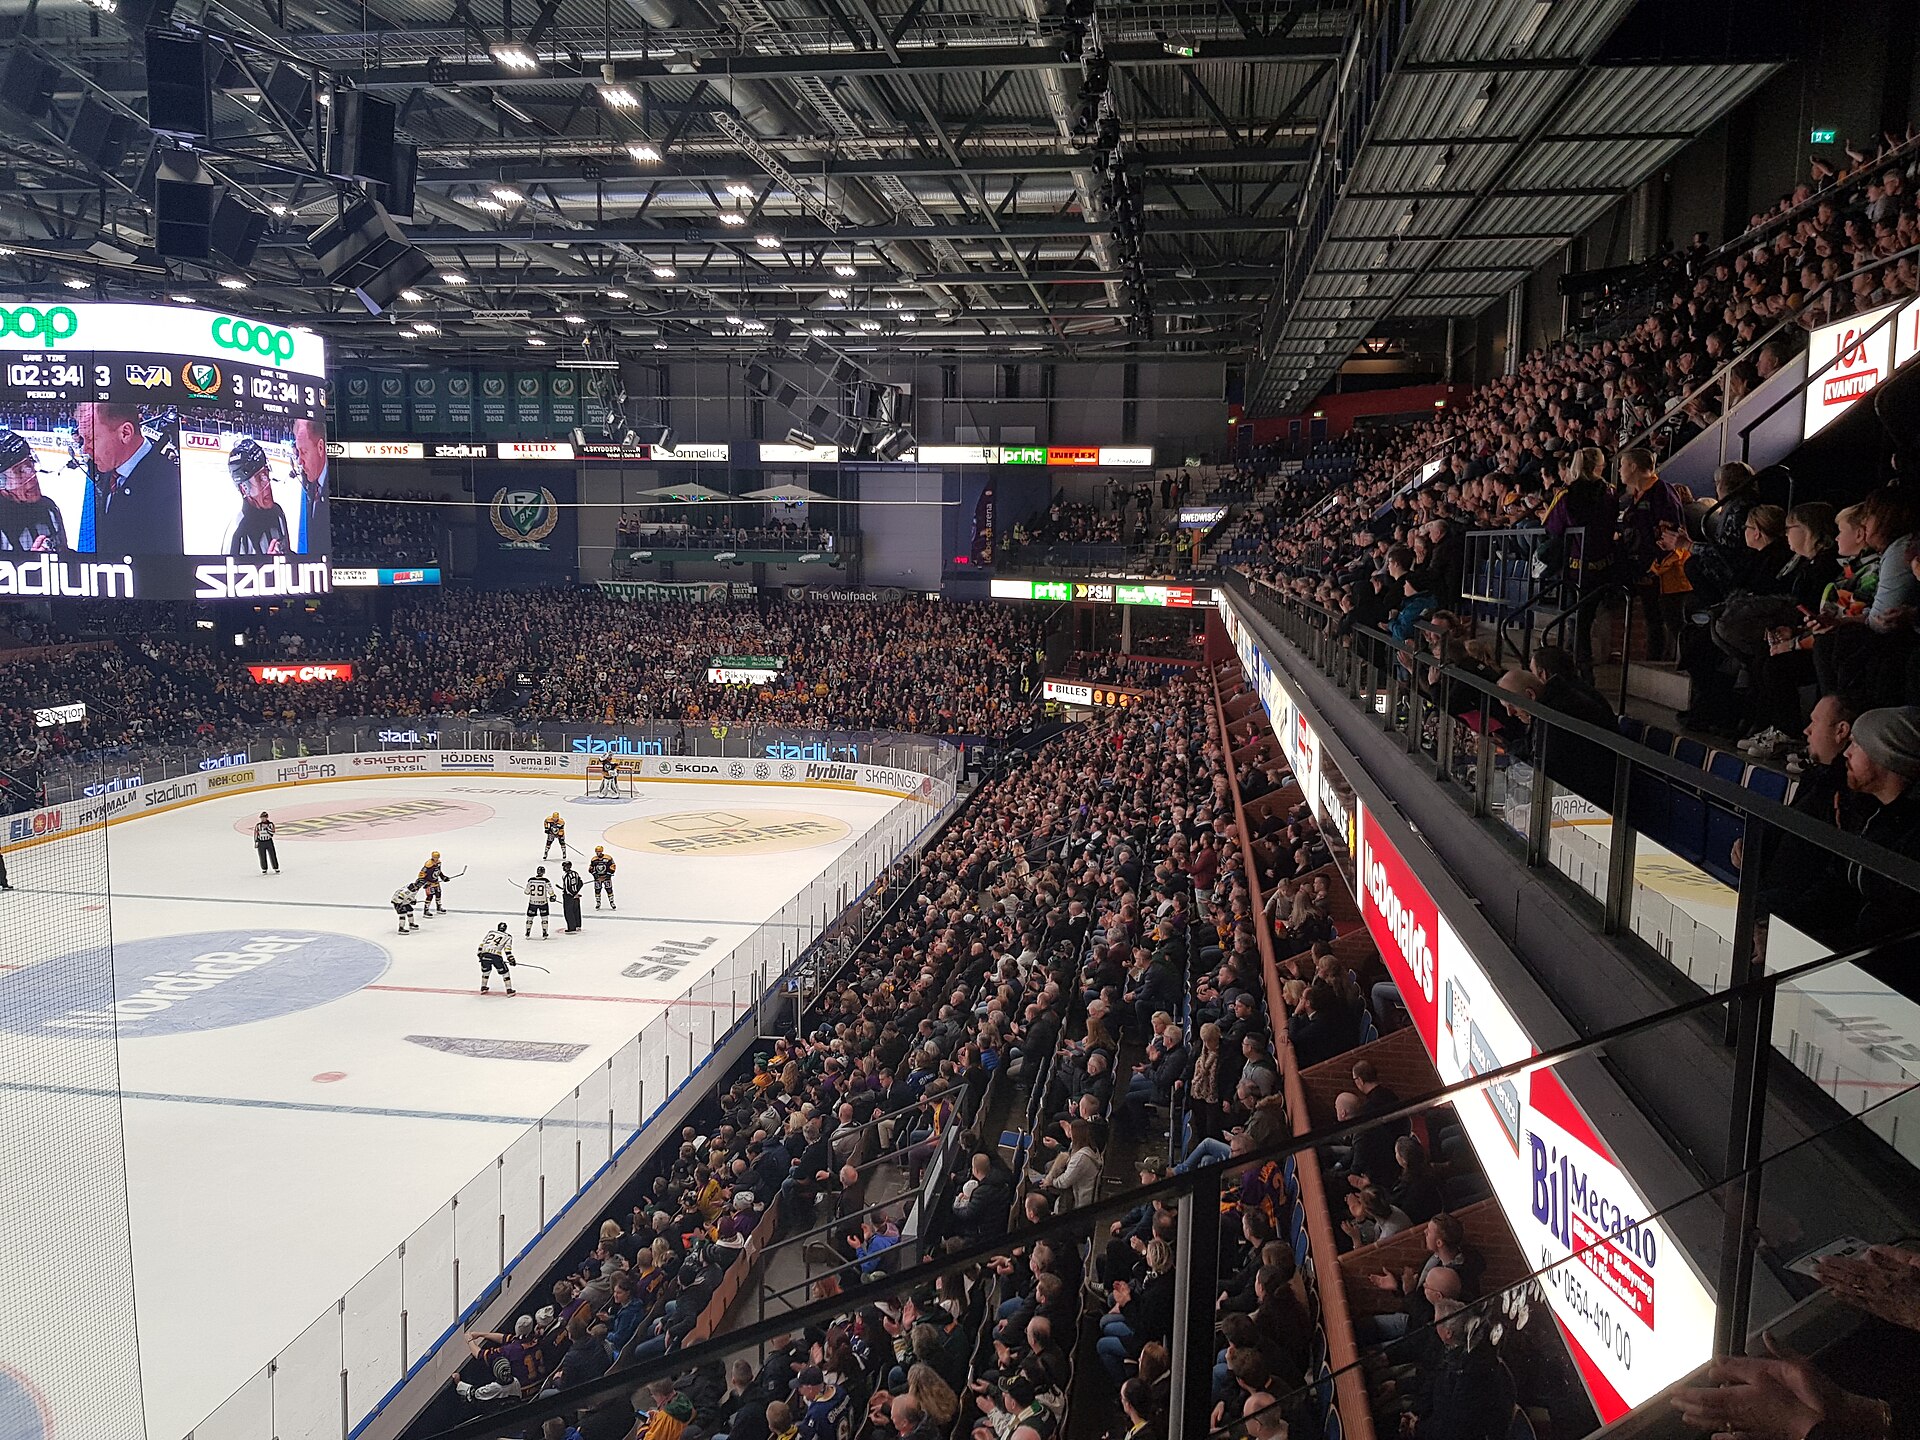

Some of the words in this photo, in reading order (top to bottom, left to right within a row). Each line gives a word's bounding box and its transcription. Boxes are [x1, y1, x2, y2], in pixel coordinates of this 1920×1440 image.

[0, 306, 78, 347] op
[211, 316, 295, 366] coop
[1836, 327, 1867, 370] ICA
[11, 364, 80, 387] 02:34
[95, 365, 111, 387] 3
[232, 374, 244, 395] 3
[59, 391, 66, 399] 4
[253, 378, 297, 403] 02:34
[304, 386, 315, 406] 3
[1825, 372, 1877, 401] KVANTUM
[188, 436, 219, 448] JULA
[366, 446, 376, 454] Vi
[380, 445, 409, 455] SYNS
[435, 444, 487, 458] stadium
[513, 444, 557, 452] KELTOX
[1006, 448, 1044, 463] print
[1050, 451, 1096, 459] UNIFLEX
[985, 503, 993, 527] arena
[0, 554, 134, 598] adium
[195, 554, 329, 599] stadium
[809, 591, 828, 600] The
[830, 591, 878, 602] Wolfpack
[1034, 582, 1067, 599] print
[1087, 585, 1112, 598] PSM
[300, 667, 338, 681] City
[1055, 684, 1088, 697] BILLES
[573, 735, 662, 756] stadium
[199, 750, 247, 770] stadium
[440, 752, 495, 763] HÖJDENS
[544, 755, 557, 766] Bil
[675, 763, 719, 774] ŠKODA
[805, 763, 859, 781] Hyrbilar
[84, 773, 142, 797] stadium
[865, 769, 917, 790] SKARINGS
[145, 779, 197, 807] stadium
[446, 786, 559, 795] Scandic
[79, 790, 137, 825] FRYKMALM
[10, 810, 61, 840] ELON
[649, 821, 829, 849] BEIJER
[530, 884, 545, 897] 29
[1364, 839, 1434, 1004] McDonald's
[485, 934, 503, 946] 24
[620, 936, 719, 982] SHL
[42, 935, 322, 1030] NordicBet
[1531, 1131, 1570, 1250] Bil
[1571, 1163, 1657, 1268] Mecano
[1565, 1268, 1611, 1349] 0554-410
[1615, 1323, 1631, 1371] 00
